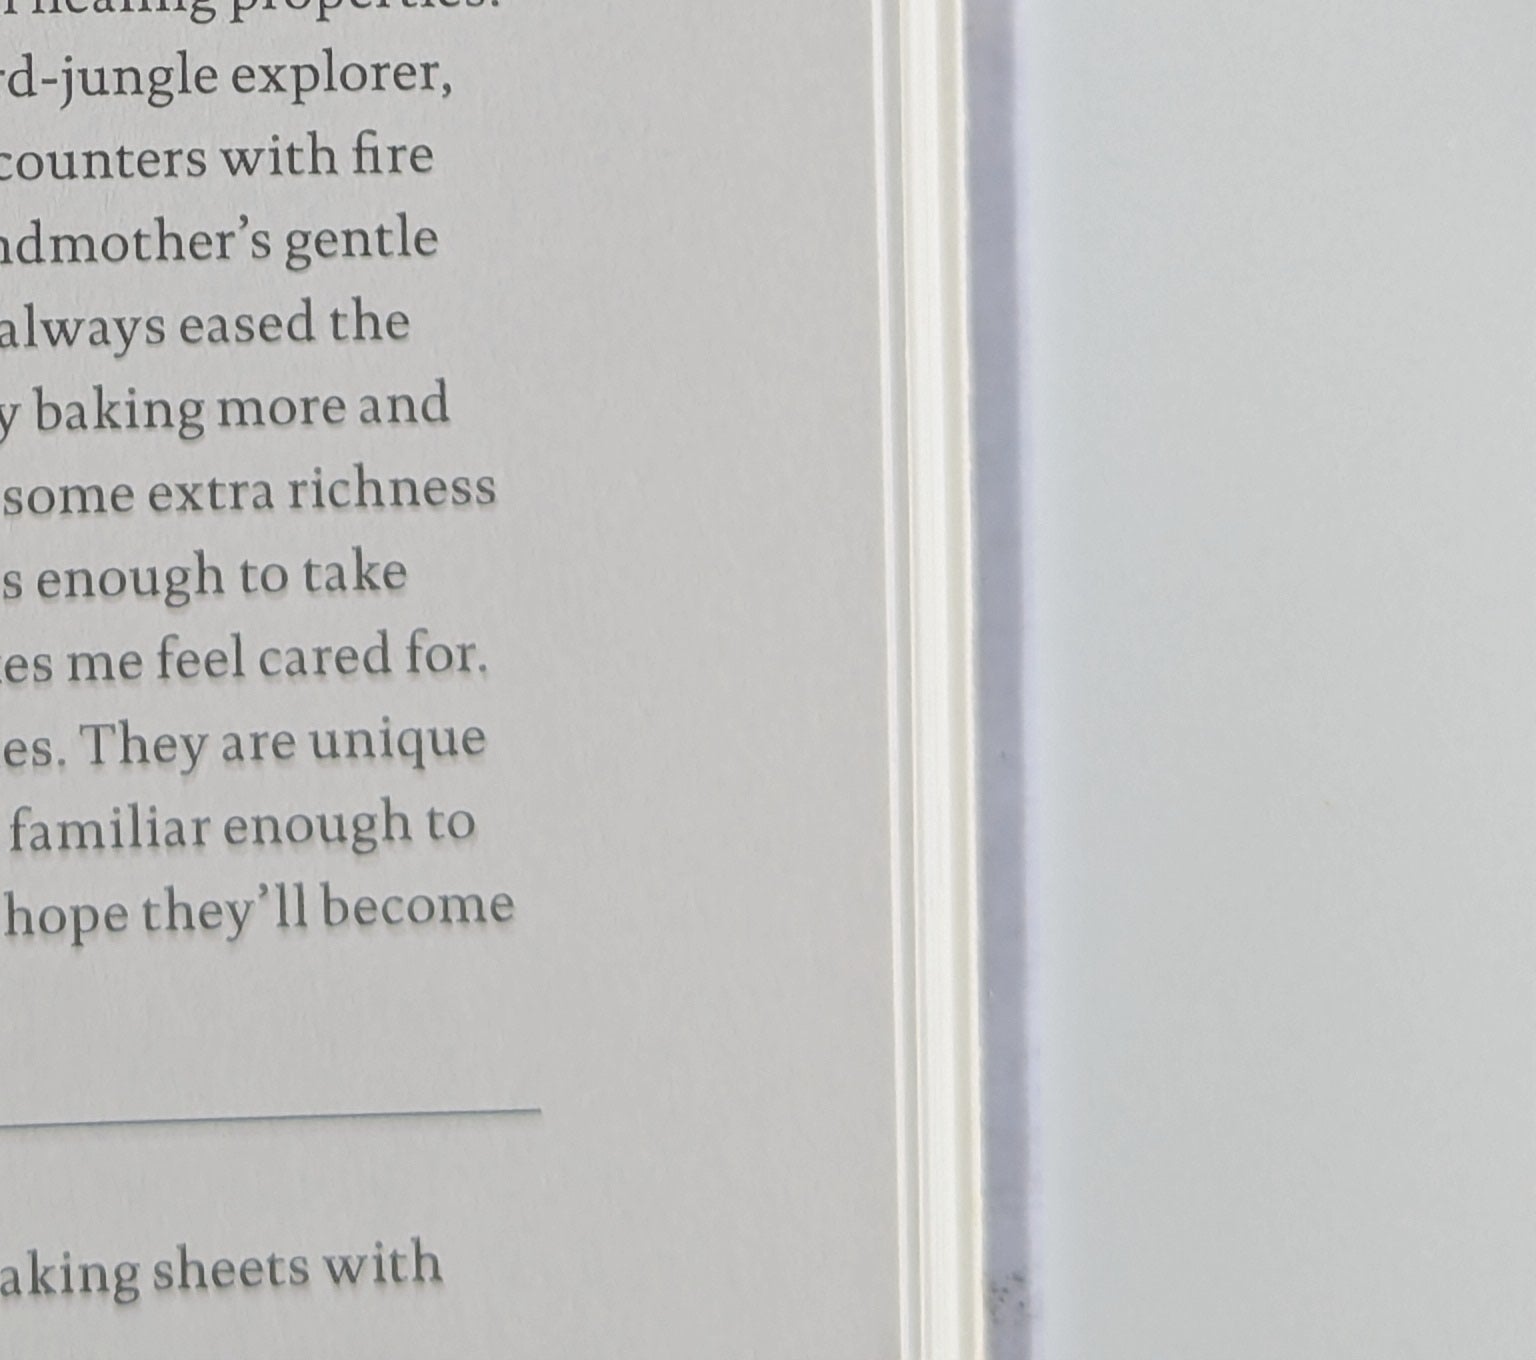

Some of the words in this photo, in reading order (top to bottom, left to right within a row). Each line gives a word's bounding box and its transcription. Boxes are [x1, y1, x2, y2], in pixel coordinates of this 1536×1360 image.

[232, 47, 451, 105] explorer,
[285, 212, 438, 273] gentle
[33, 384, 204, 442] baking
[218, 396, 346, 427] more
[360, 377, 450, 425] and
[4, 484, 134, 516] some
[149, 478, 274, 514] extra
[289, 462, 495, 510] richness
[67, 651, 142, 682] me
[158, 632, 245, 681] feel
[259, 629, 392, 677] cared
[407, 628, 486, 674] for.
[79, 719, 208, 776] They
[223, 732, 295, 763] are
[309, 716, 485, 771] unique
[4, 891, 128, 948] hope
[143, 882, 307, 943] they’ll
[321, 882, 514, 928] become
[154, 1244, 309, 1292] sheets
[323, 1237, 443, 1287] with
